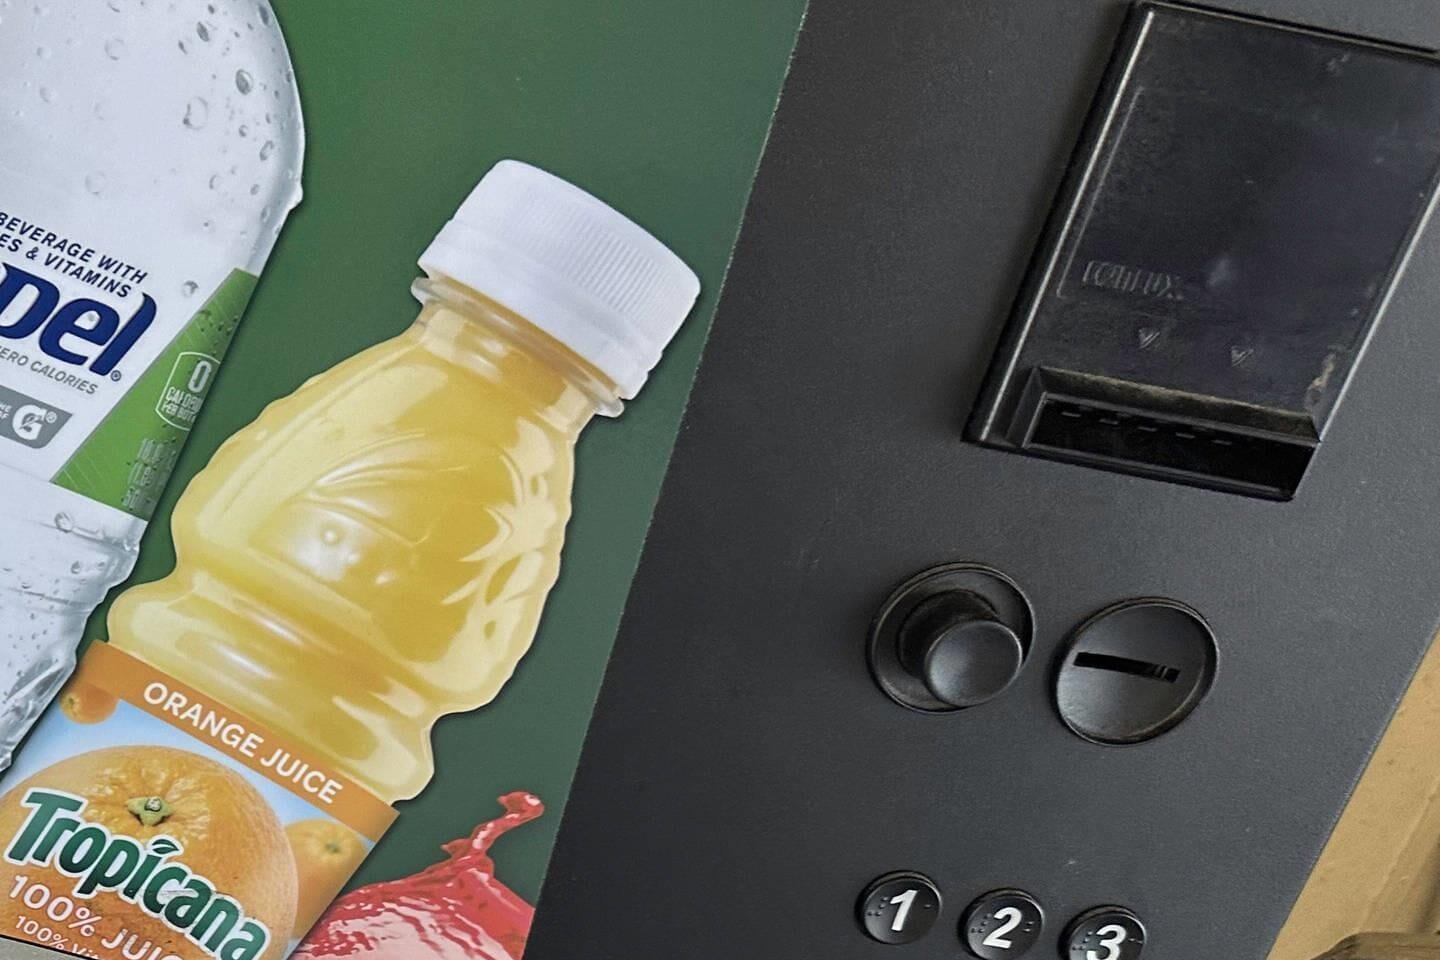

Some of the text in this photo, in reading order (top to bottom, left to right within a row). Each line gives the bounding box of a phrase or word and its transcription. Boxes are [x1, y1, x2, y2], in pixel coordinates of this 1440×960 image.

[26, 246, 39, 260] &
[44, 252, 132, 298] VITAMINS
[98, 254, 148, 284] WITH
[30, 360, 99, 395] CALORIES
[188, 360, 212, 393] 0
[143, 681, 344, 804] ORANGE JUICE
[9, 874, 102, 937] 100%
[890, 889, 918, 932] 1
[15, 915, 69, 950] 100%
[982, 906, 1022, 949] 2
